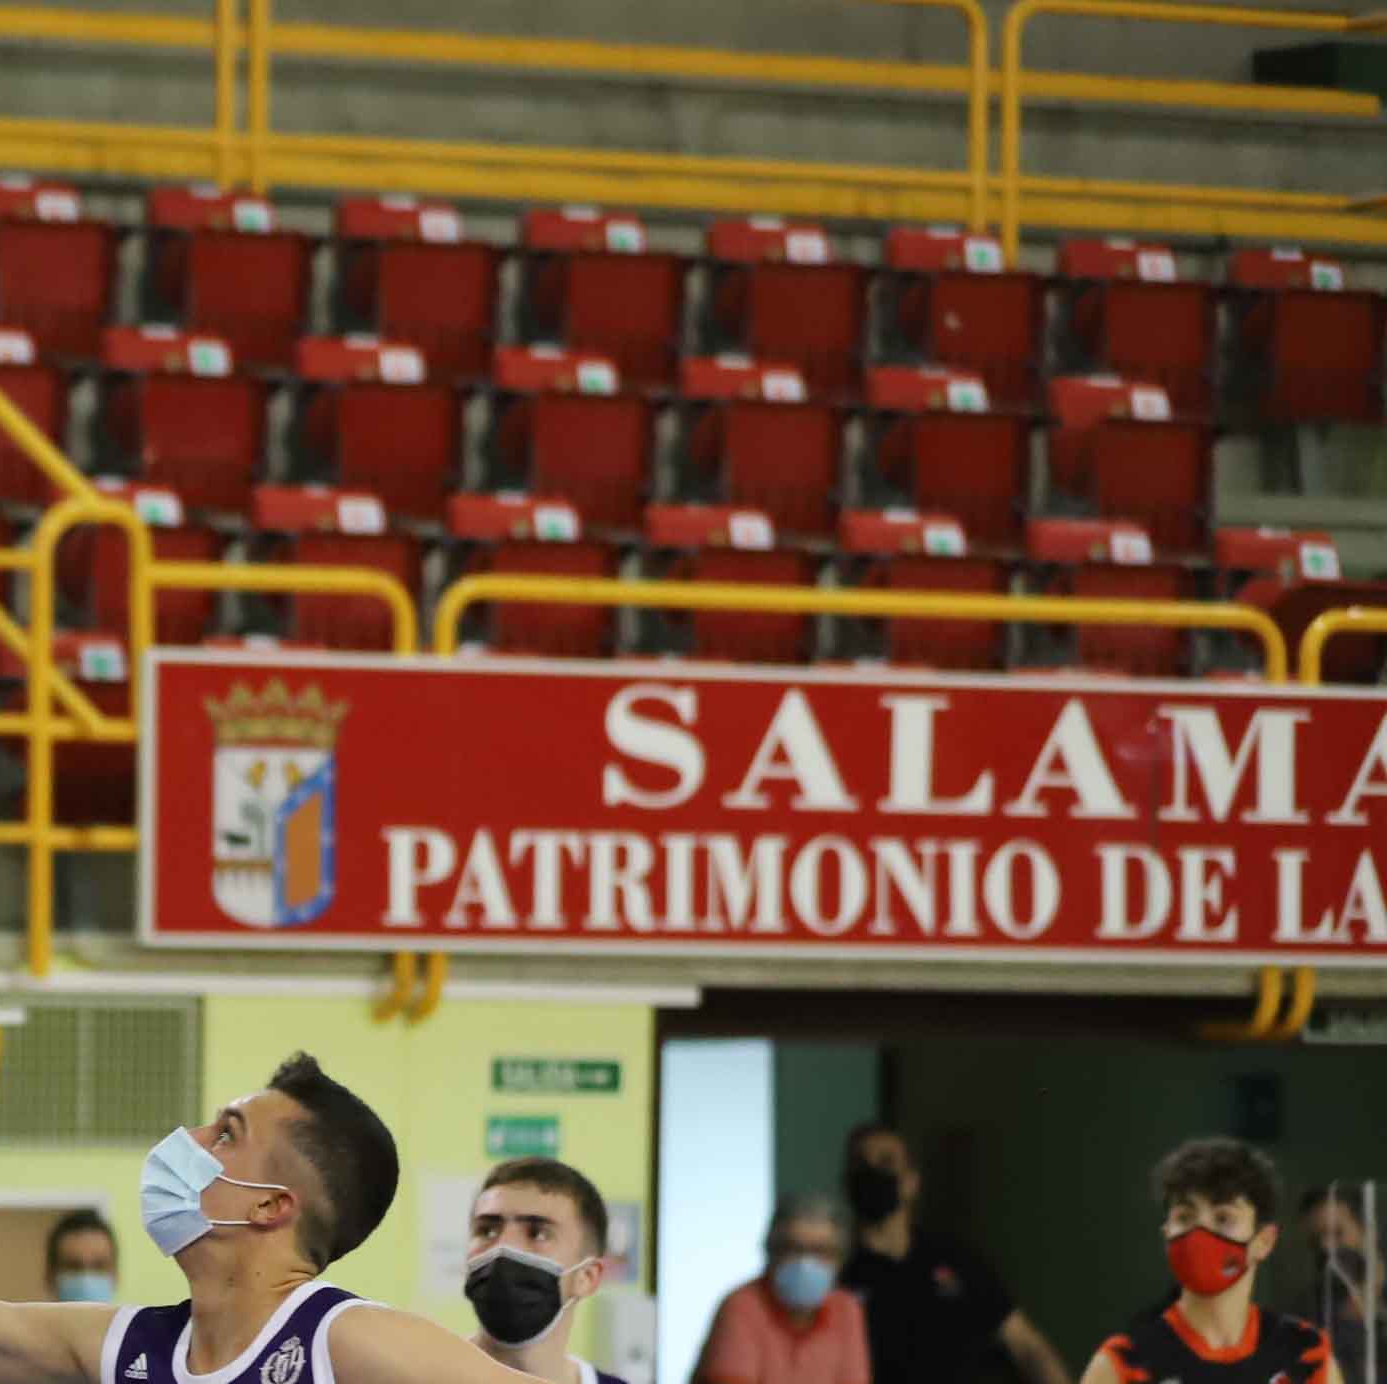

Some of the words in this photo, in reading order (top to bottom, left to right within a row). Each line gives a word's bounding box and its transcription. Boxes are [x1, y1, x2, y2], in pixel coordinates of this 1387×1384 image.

[381, 825, 1062, 939] PATRIMONIO
[1094, 842, 1239, 943] DE
[1273, 847, 1387, 945] LA
